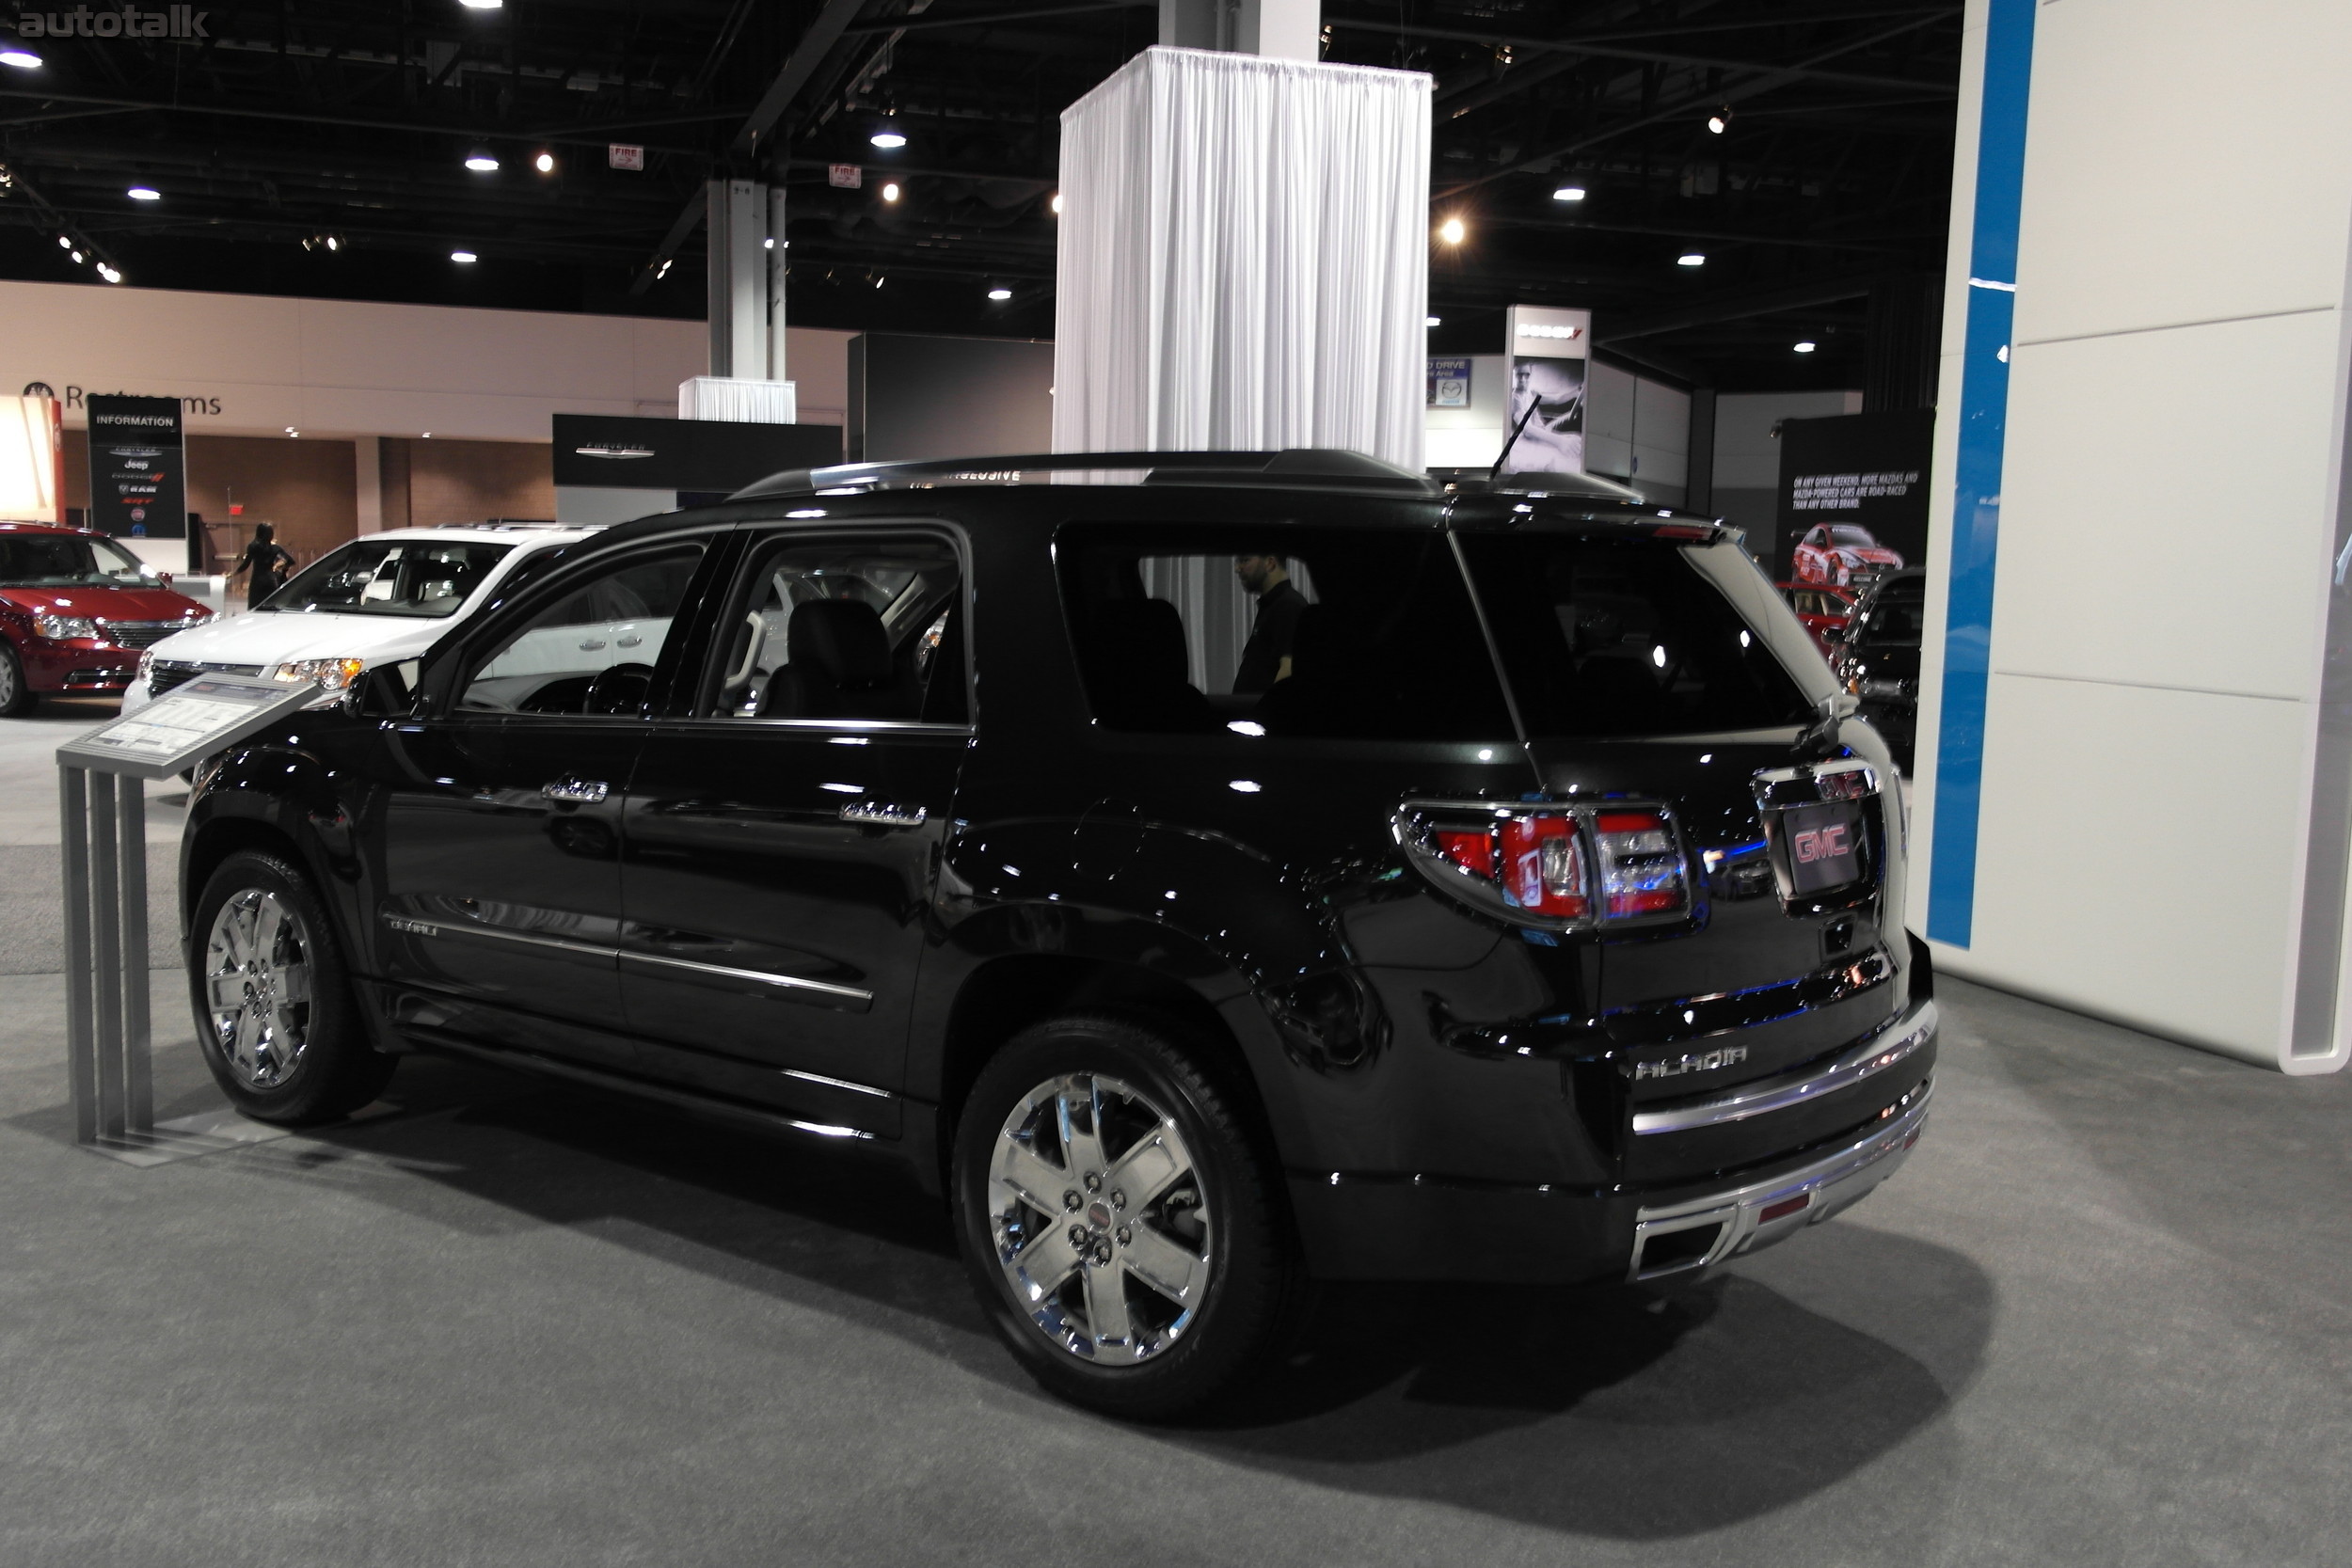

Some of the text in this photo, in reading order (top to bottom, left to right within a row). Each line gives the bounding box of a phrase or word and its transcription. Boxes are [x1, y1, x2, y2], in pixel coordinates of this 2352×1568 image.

[614, 148, 637, 157] FIRE
[834, 166, 855, 176] FIRE
[1436, 361, 1465, 370] DRIVE
[96, 414, 174, 428] INFORMATION
[124, 459, 149, 470] Jeep
[1793, 477, 1803, 488] ON
[1803, 477, 1815, 487] ANY
[1815, 476, 1832, 487] GIVEN
[1861, 474, 1878, 485] MORE
[1879, 473, 1903, 484] MAZDAS
[1904, 472, 1918, 483] AND
[1792, 485, 1907, 499] MAZDA-POWERED CARS ARE ROAD-RACED
[1792, 499, 1808, 510] THAN
[1806, 499, 1820, 510] ANY
[1820, 499, 1839, 510] OTHER
[1795, 823, 1850, 863] GMC
